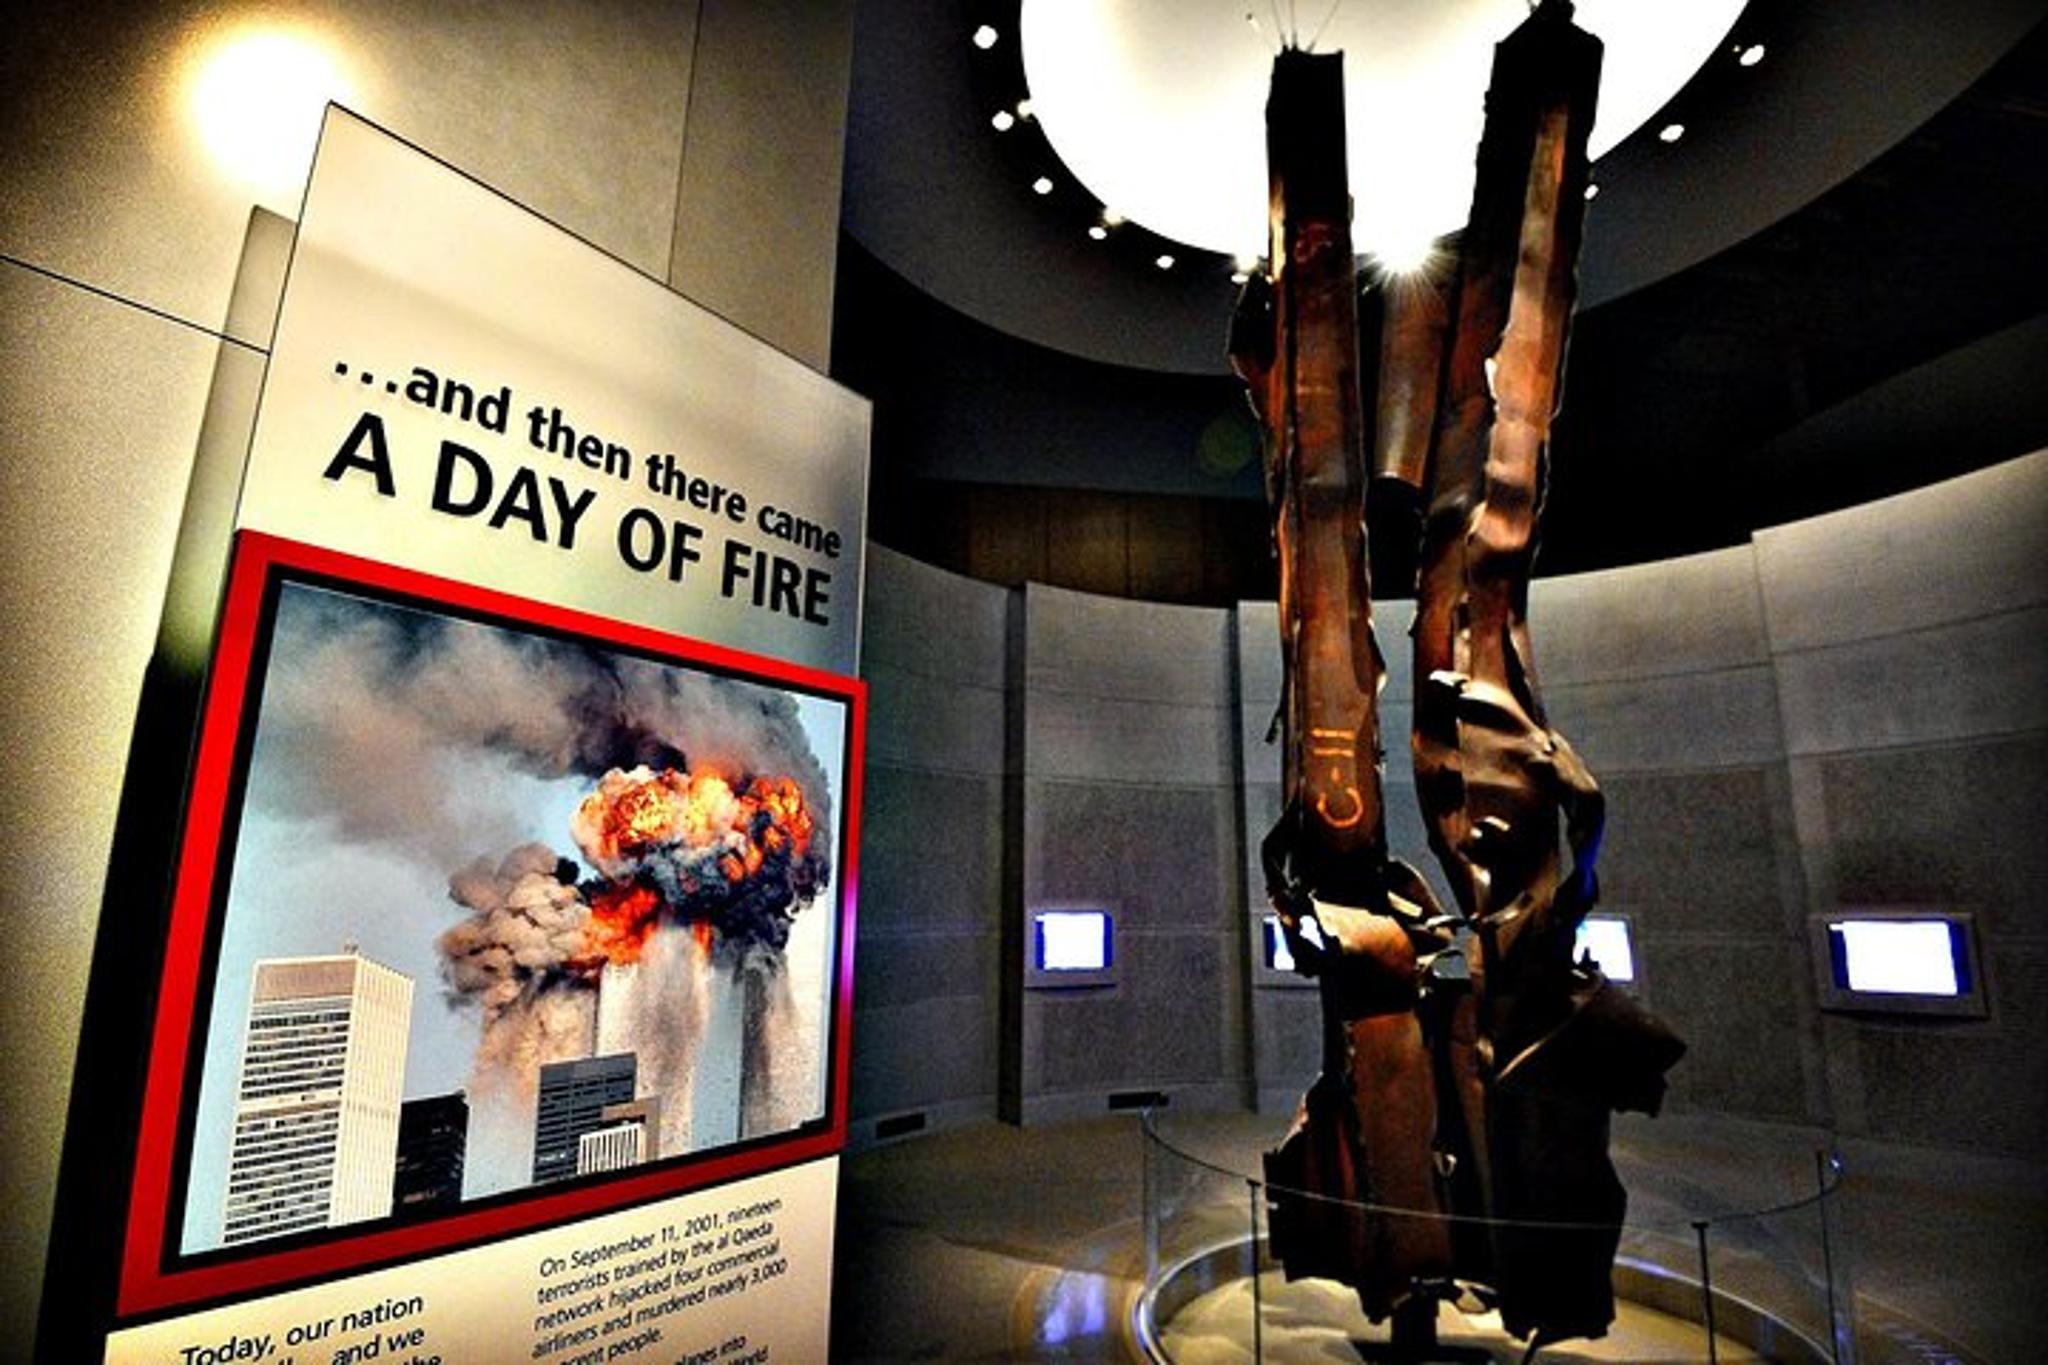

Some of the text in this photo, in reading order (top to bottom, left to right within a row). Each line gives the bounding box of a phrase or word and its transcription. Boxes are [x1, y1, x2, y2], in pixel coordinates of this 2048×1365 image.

[323, 411, 832, 627] A DAY OF FIRE
[527, 406, 632, 480] then
[645, 454, 747, 522] there
[757, 504, 842, 559] came
[537, 1271, 610, 1304] terrorists
[613, 1252, 668, 1280] trained
[671, 1247, 688, 1266] by
[691, 1240, 714, 1258] the
[732, 1221, 774, 1246] Qaeda
[539, 1198, 783, 1277] On September 11, 2001, nineteen
[531, 1325, 599, 1359] airliners
[601, 1309, 632, 1335] and
[635, 1285, 706, 1324] murdered
[708, 1273, 748, 1299] nearly
[751, 1257, 788, 1286] 3,000
[534, 1237, 780, 1331] network hijacked four commercial
[180, 1296, 425, 1365] Today, our nation
[332, 1328, 425, 1365] and we
[608, 1327, 663, 1361] people.
[720, 1335, 747, 1357] into
